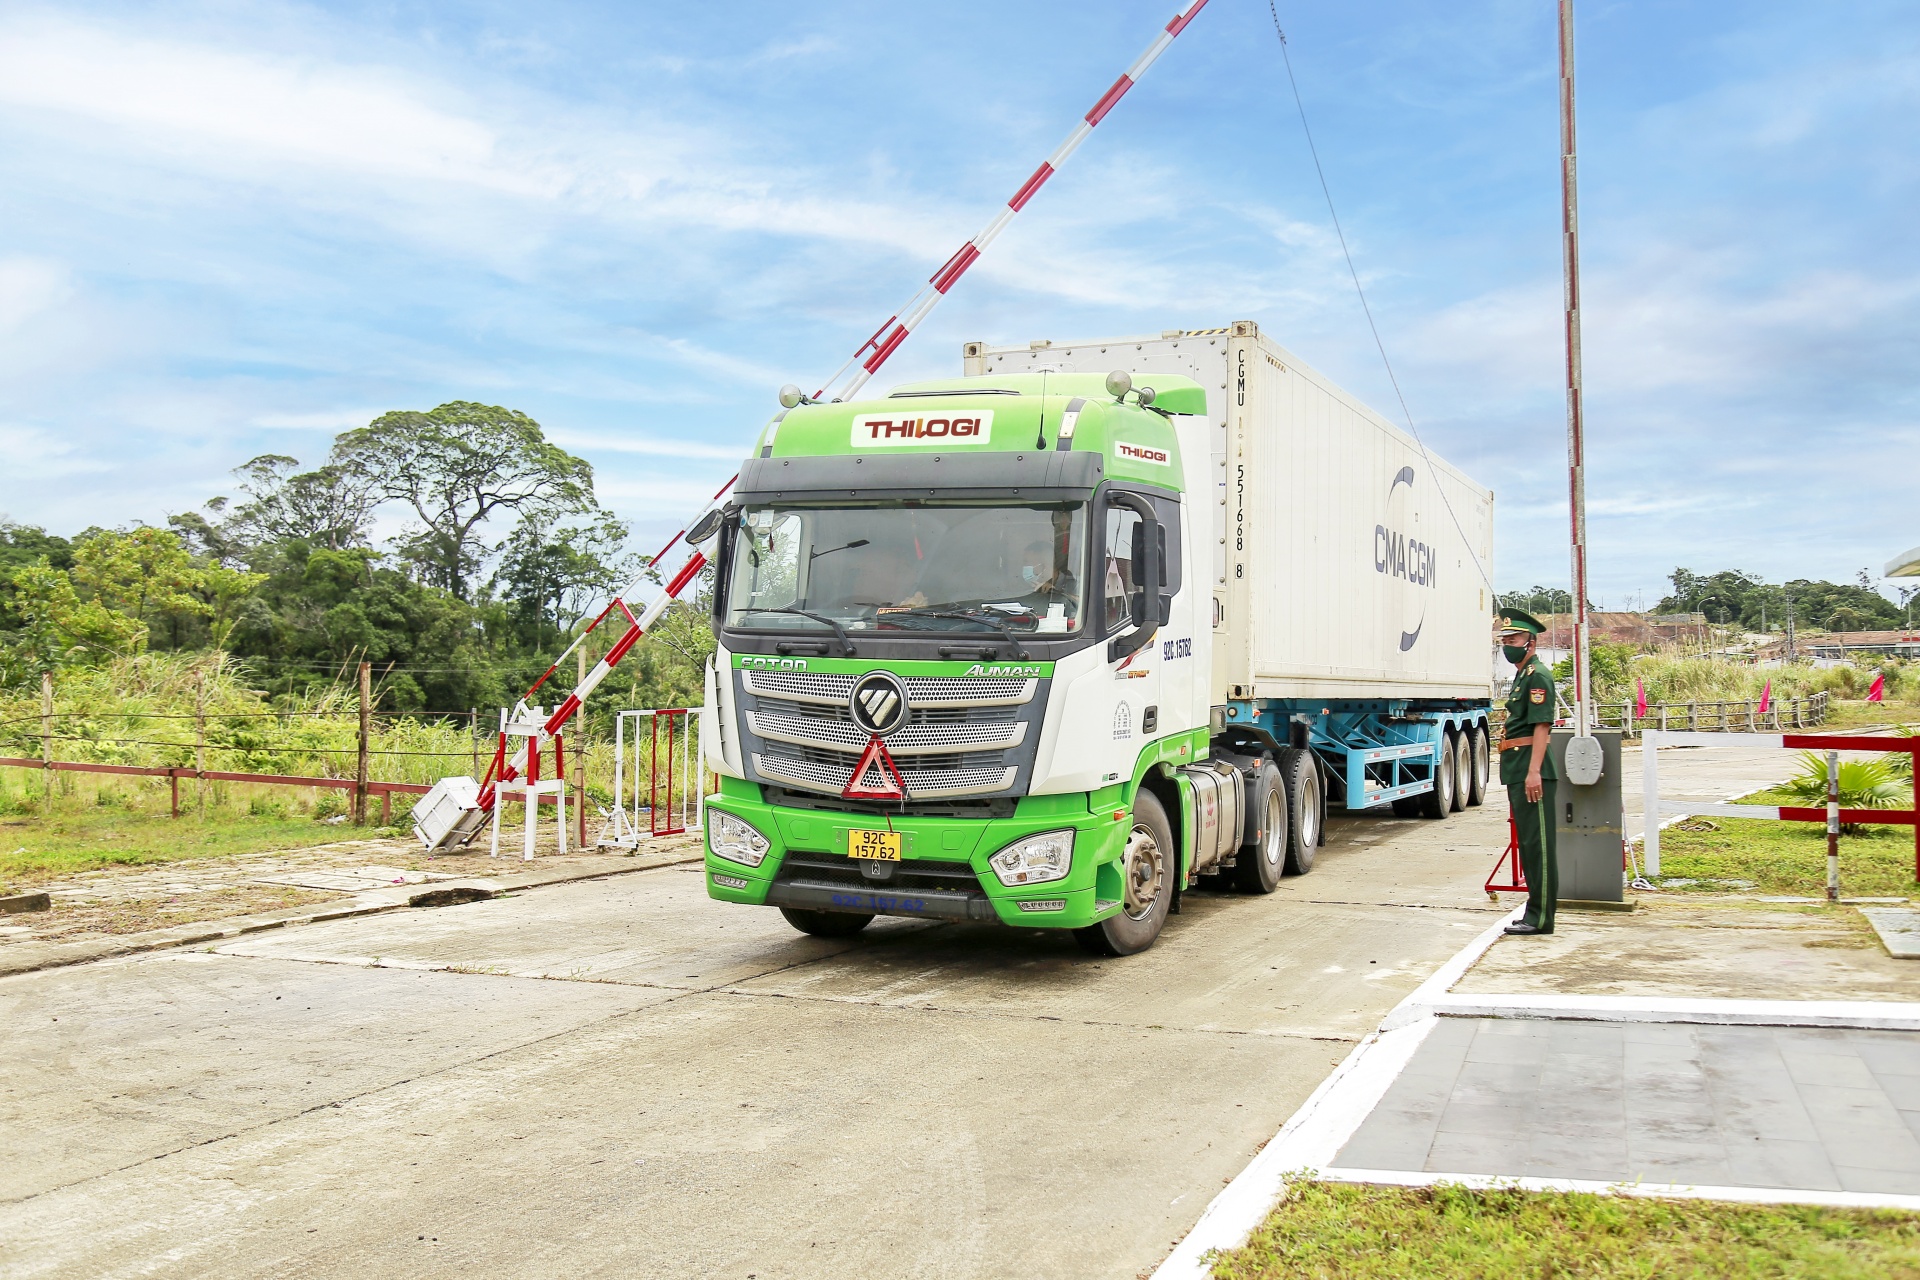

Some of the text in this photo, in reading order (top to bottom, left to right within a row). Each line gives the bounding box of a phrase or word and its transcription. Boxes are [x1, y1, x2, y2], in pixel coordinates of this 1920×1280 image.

[1237, 349, 1245, 407] CGMU
[864, 418, 981, 438] THILOGI
[1119, 445, 1167, 462] THILOGI
[1236, 464, 1244, 551] 551668
[1374, 524, 1436, 589] CMA CGM
[863, 832, 886, 845] 92C
[855, 845, 895, 860] 157.62
